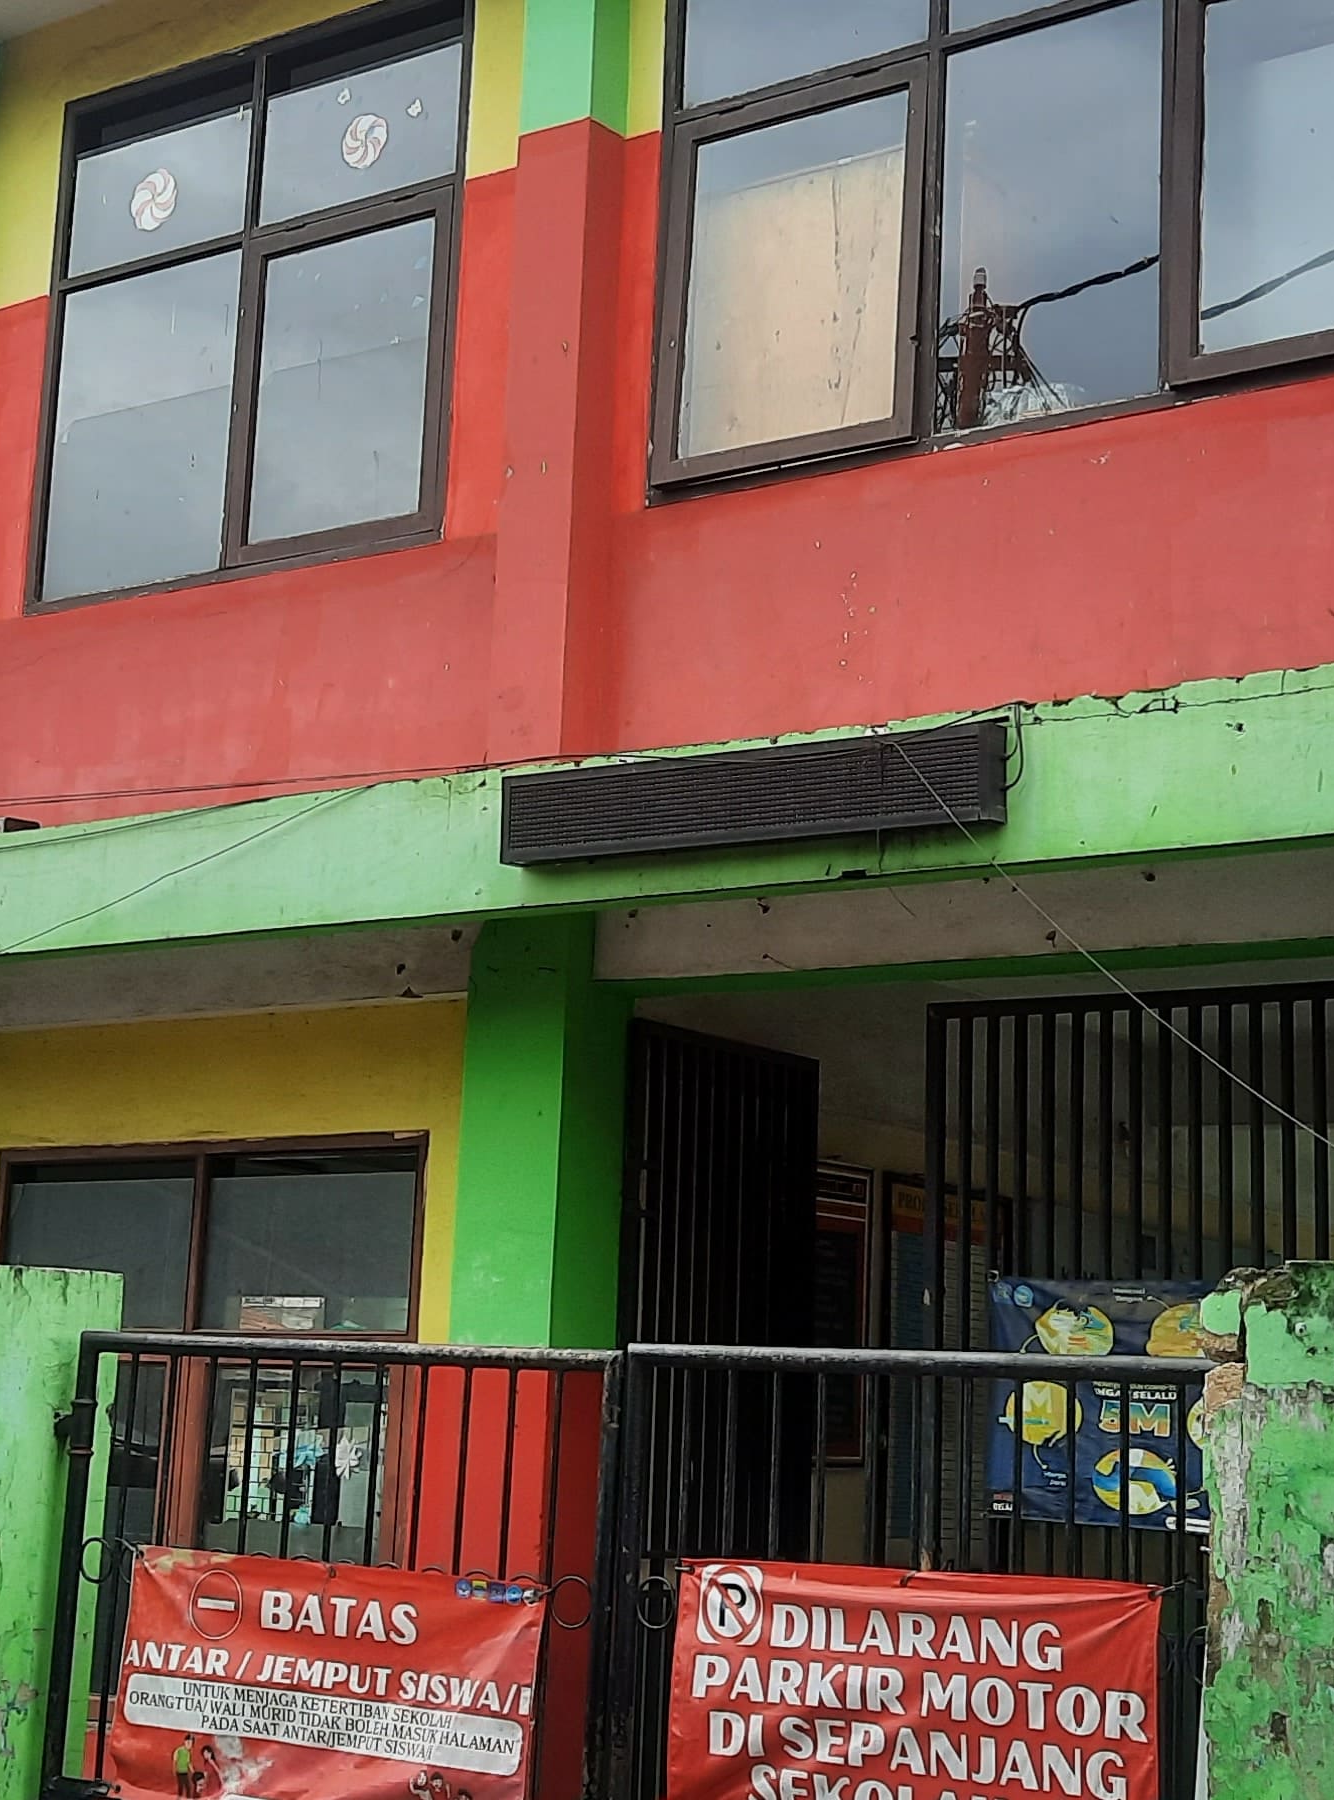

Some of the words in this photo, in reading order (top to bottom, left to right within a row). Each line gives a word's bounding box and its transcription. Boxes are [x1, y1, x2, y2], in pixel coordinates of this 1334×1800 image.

[1098, 1400, 1170, 1437] 5M
[260, 1590, 418, 1644] BATAS
[770, 1604, 1062, 1672] DILARANG
[124, 1639, 230, 1677] ANTAR
[235, 1651, 253, 1680] /
[256, 1654, 392, 1696] JEMPUT
[183, 1682, 230, 1700] UNTUK
[234, 1690, 298, 1712] MENJAGA
[301, 1697, 390, 1721] KETERTIBAN
[391, 1708, 452, 1729] SEKOLAH
[692, 1655, 905, 1715] PARKIR
[921, 1671, 1148, 1743] MOTOR
[201, 1715, 239, 1732] PADA
[242, 1719, 280, 1736] SAAT
[282, 1725, 383, 1752] ANTAR/JEMPUT
[249, 1704, 296, 1723] MURID
[298, 1712, 341, 1730] TIDAK
[345, 1716, 392, 1737] BOLEH
[391, 1723, 436, 1745] MASUK
[439, 1730, 515, 1755] HALAMAN
[709, 1711, 765, 1757] DI
[779, 1716, 1128, 1800] SEPANJANG
